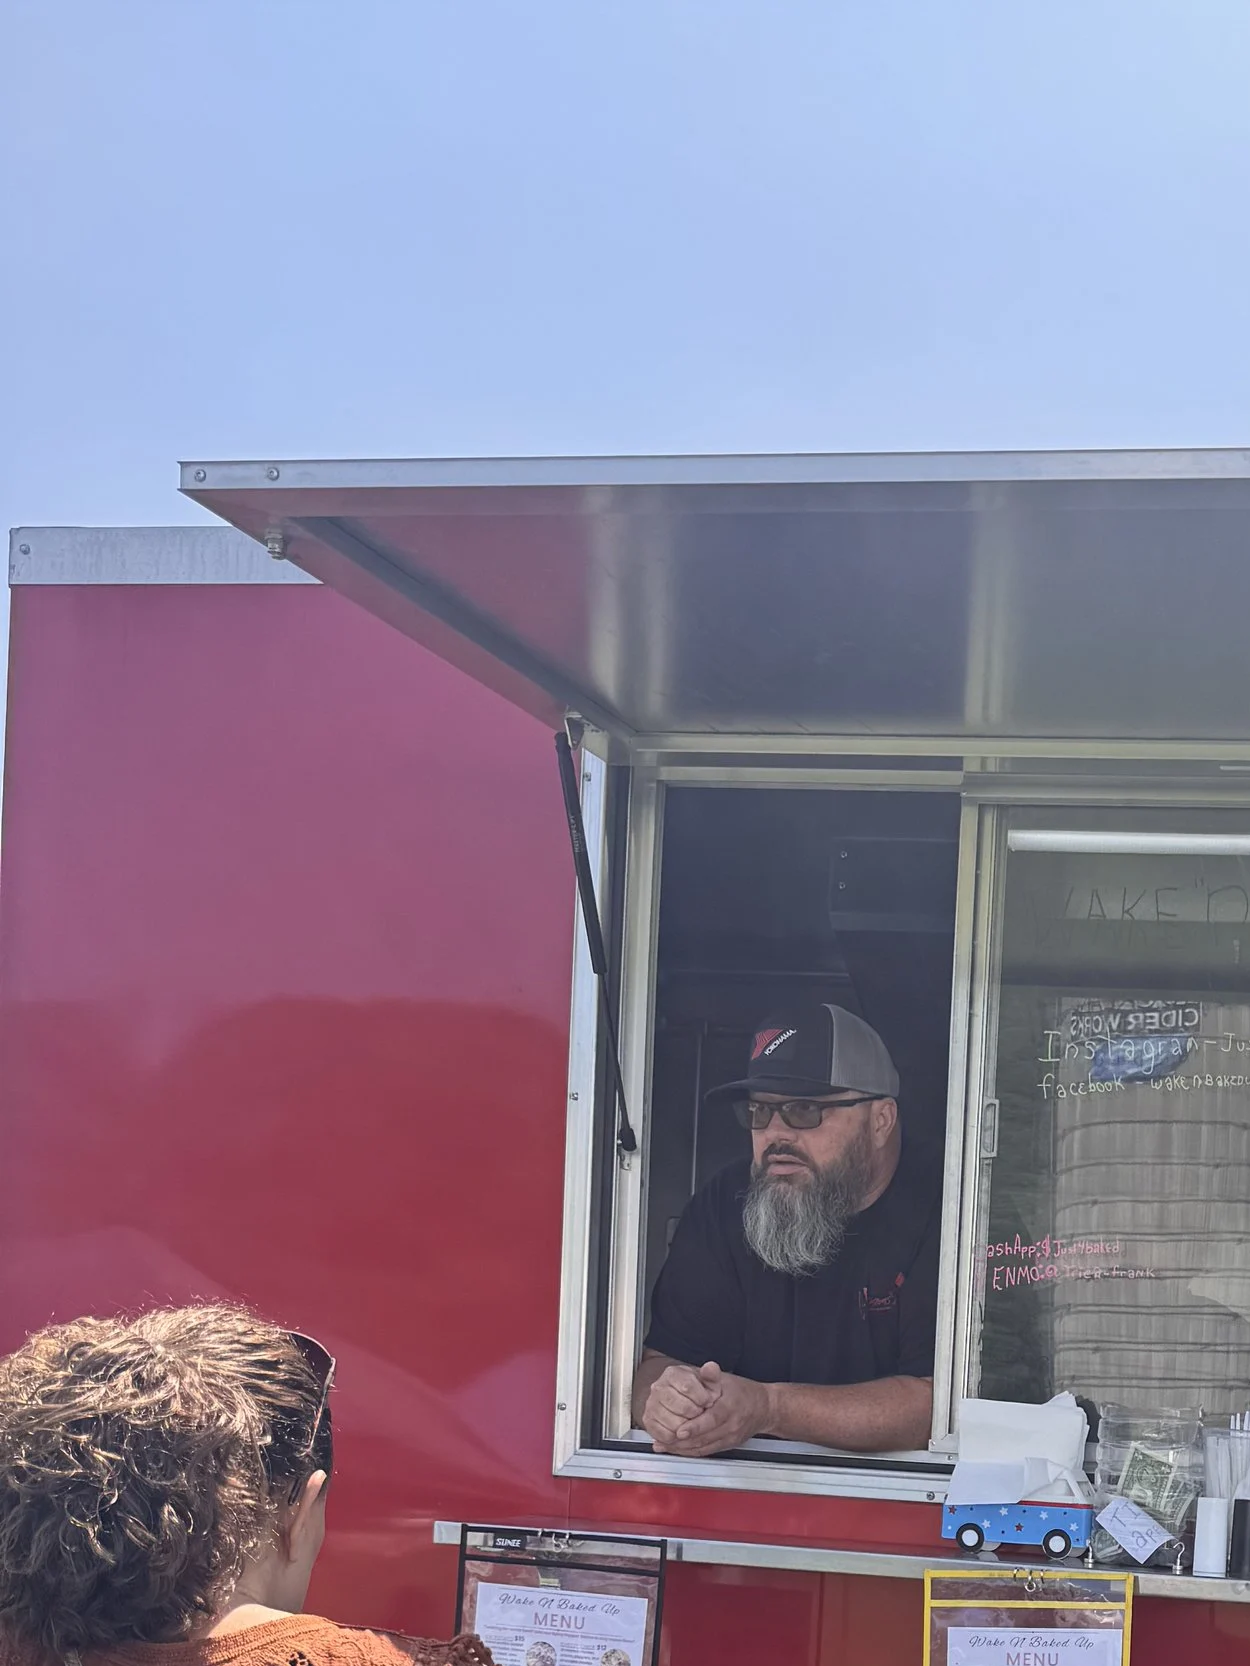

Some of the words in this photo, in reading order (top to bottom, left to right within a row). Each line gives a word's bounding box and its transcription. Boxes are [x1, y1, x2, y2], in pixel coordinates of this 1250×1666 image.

[495, 1537, 522, 1548] SUNEE
[498, 1592, 535, 1607] Wake
[557, 1597, 597, 1612] Baked
[533, 1612, 587, 1630] MENU
[969, 1635, 1006, 1648] Wake
[1009, 1636, 1026, 1649] N
[1029, 1635, 1070, 1648] Baked
[1074, 1637, 1095, 1650] Up
[1006, 1652, 1060, 1666] MENU
